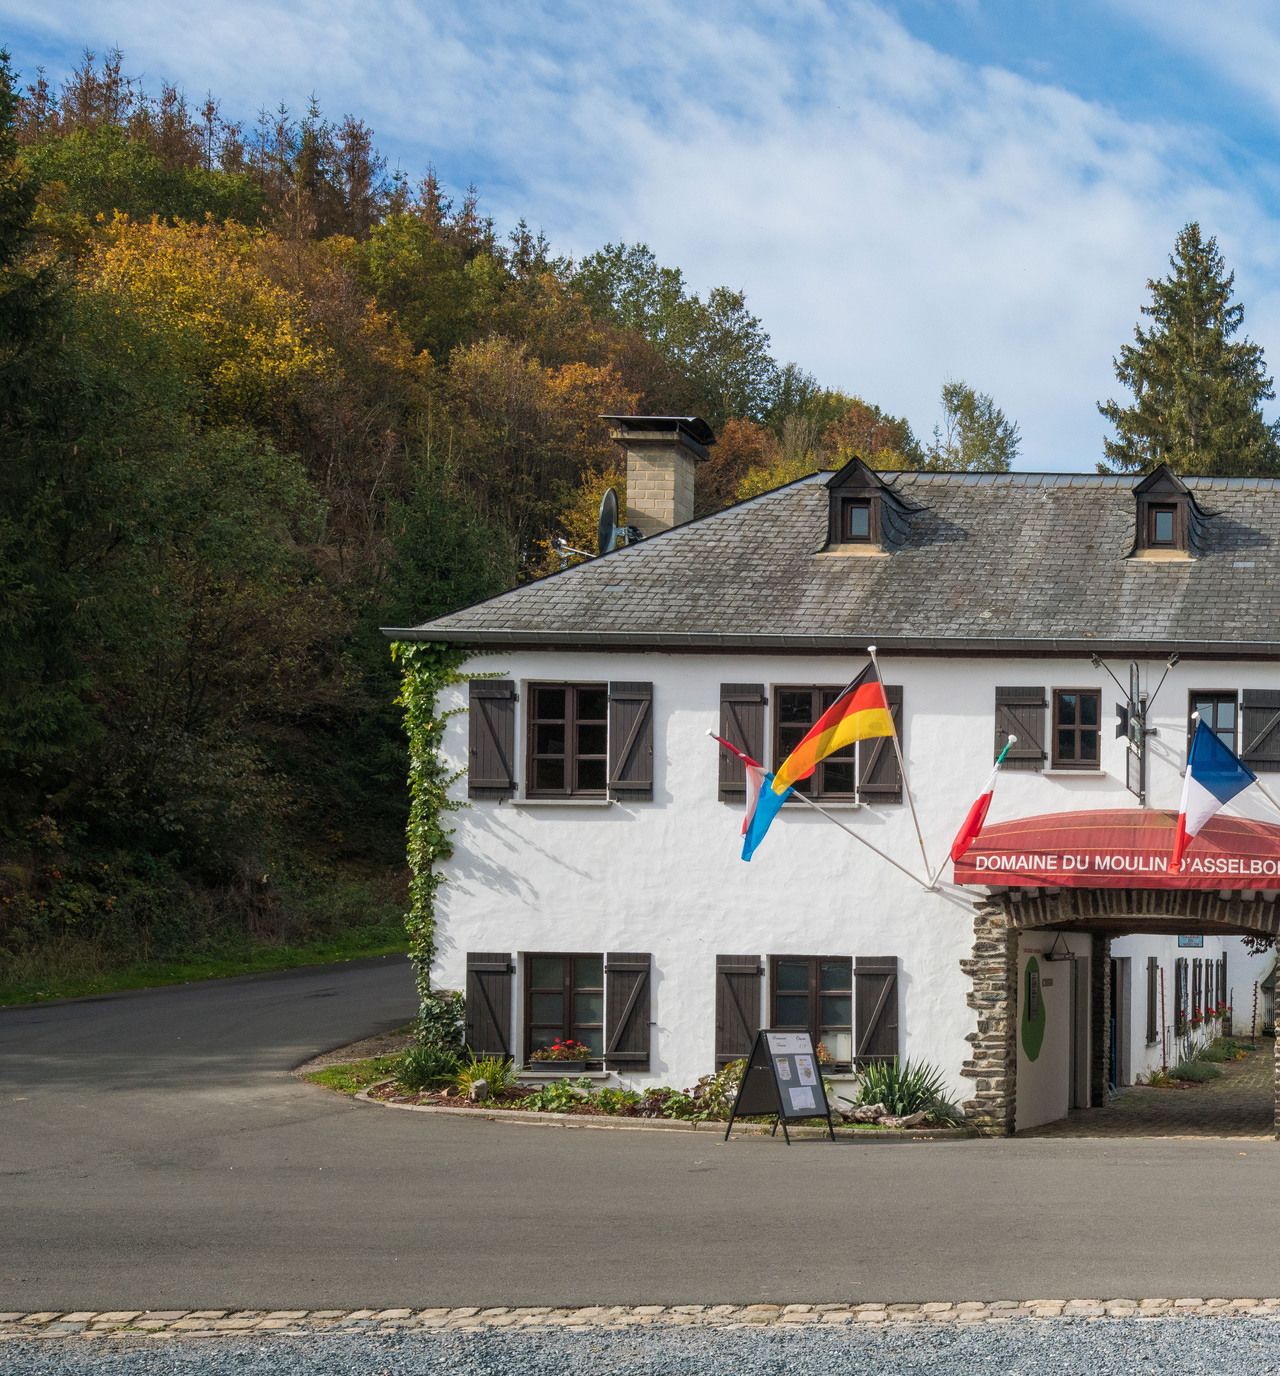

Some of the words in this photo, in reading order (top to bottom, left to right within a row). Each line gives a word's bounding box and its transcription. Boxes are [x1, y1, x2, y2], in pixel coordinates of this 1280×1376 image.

[975, 855, 1058, 871] DOMAINE
[1062, 855, 1089, 870] DU
[1094, 855, 1167, 871] MOULIN
